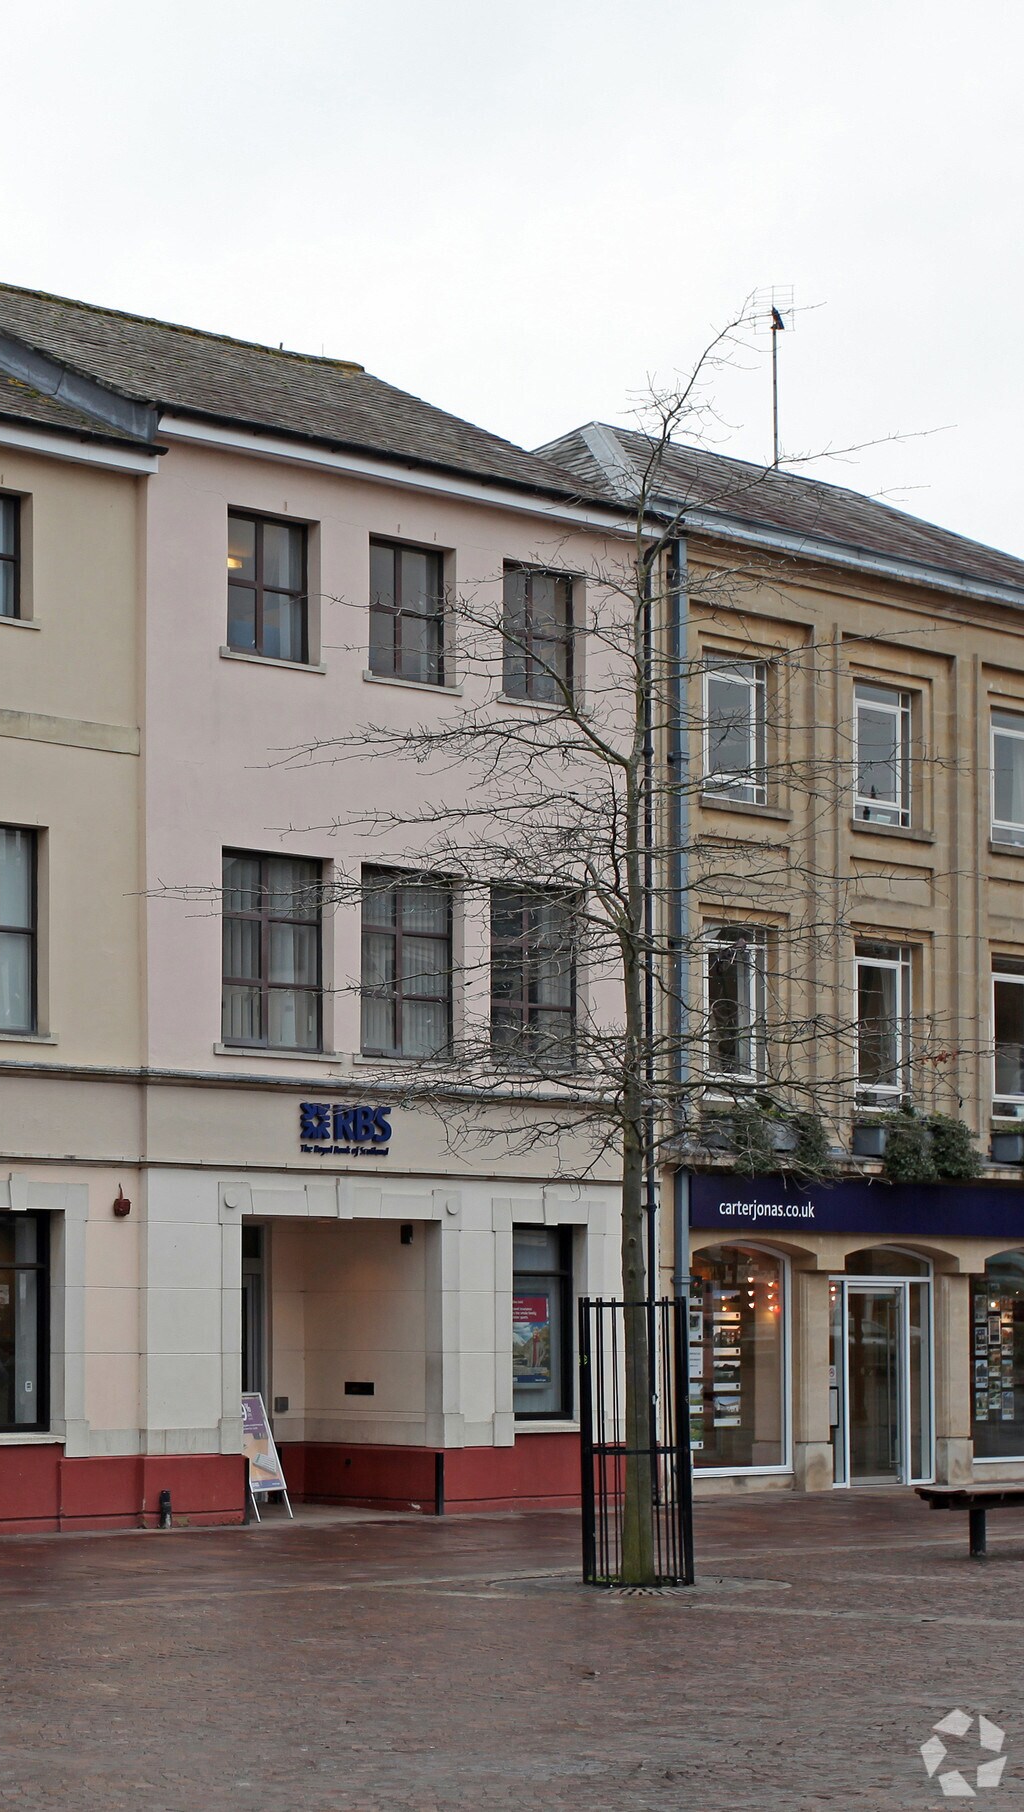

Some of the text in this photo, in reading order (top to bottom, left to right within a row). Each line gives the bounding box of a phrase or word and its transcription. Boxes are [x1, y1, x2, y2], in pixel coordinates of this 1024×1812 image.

[333, 1104, 392, 1142] RBS
[300, 1144, 313, 1153] The
[314, 1145, 333, 1156] Royal
[333, 1146, 350, 1154] Bank
[360, 1147, 389, 1156] Scotland
[719, 1200, 815, 1221] carterjonas.co.uk
